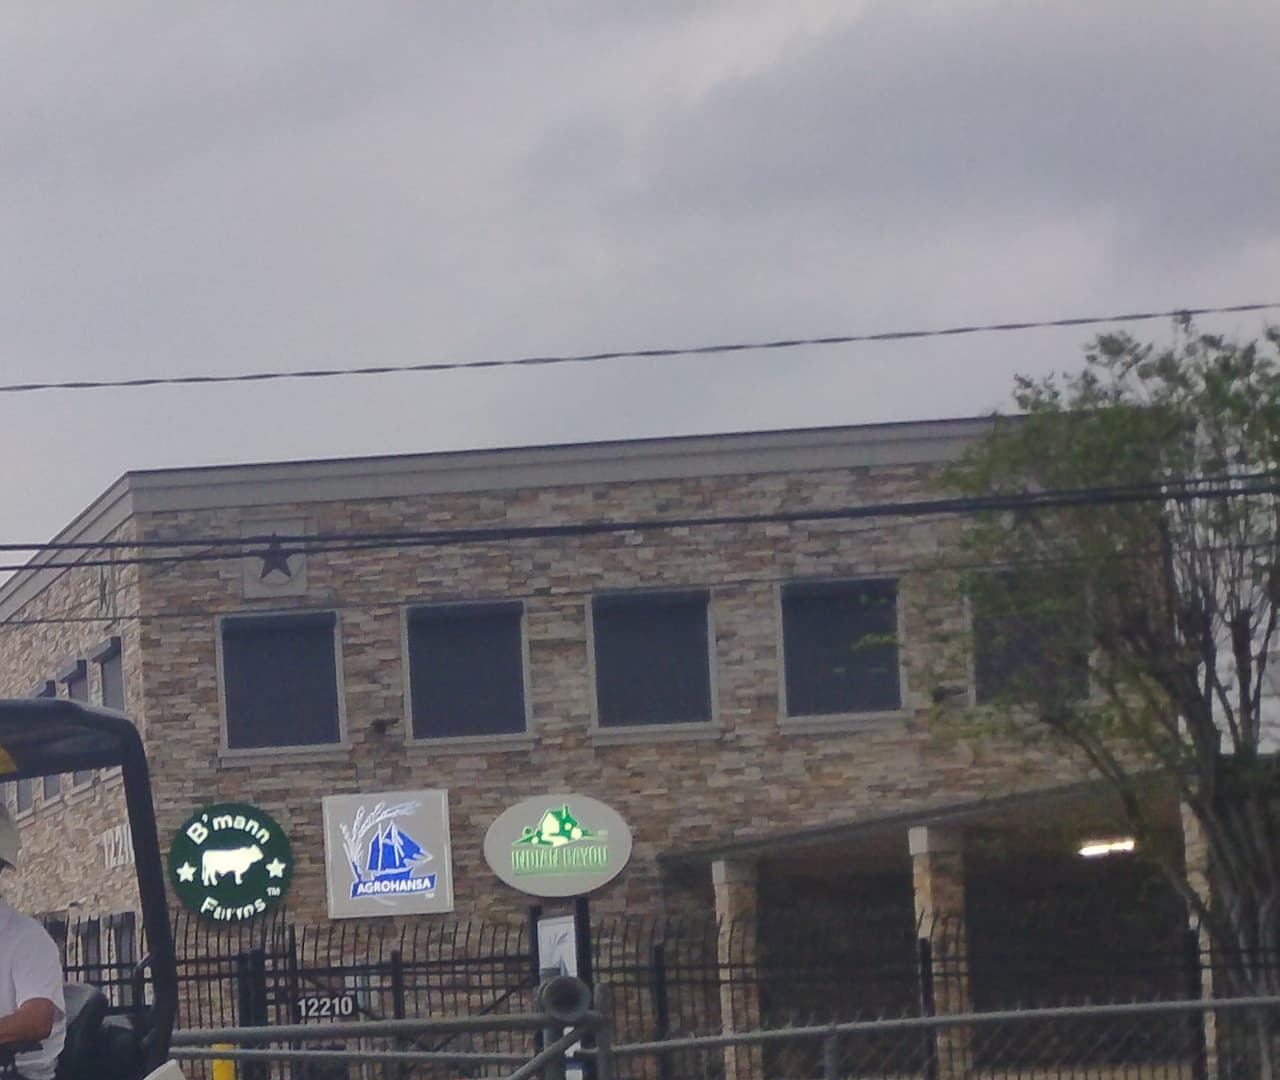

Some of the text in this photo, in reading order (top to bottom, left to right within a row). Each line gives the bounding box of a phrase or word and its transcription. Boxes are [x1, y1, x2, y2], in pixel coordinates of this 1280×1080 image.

[186, 813, 270, 845] B'mann
[356, 877, 432, 896] AGROHANSA
[200, 896, 267, 921] Farms
[297, 996, 353, 1017] 12210
